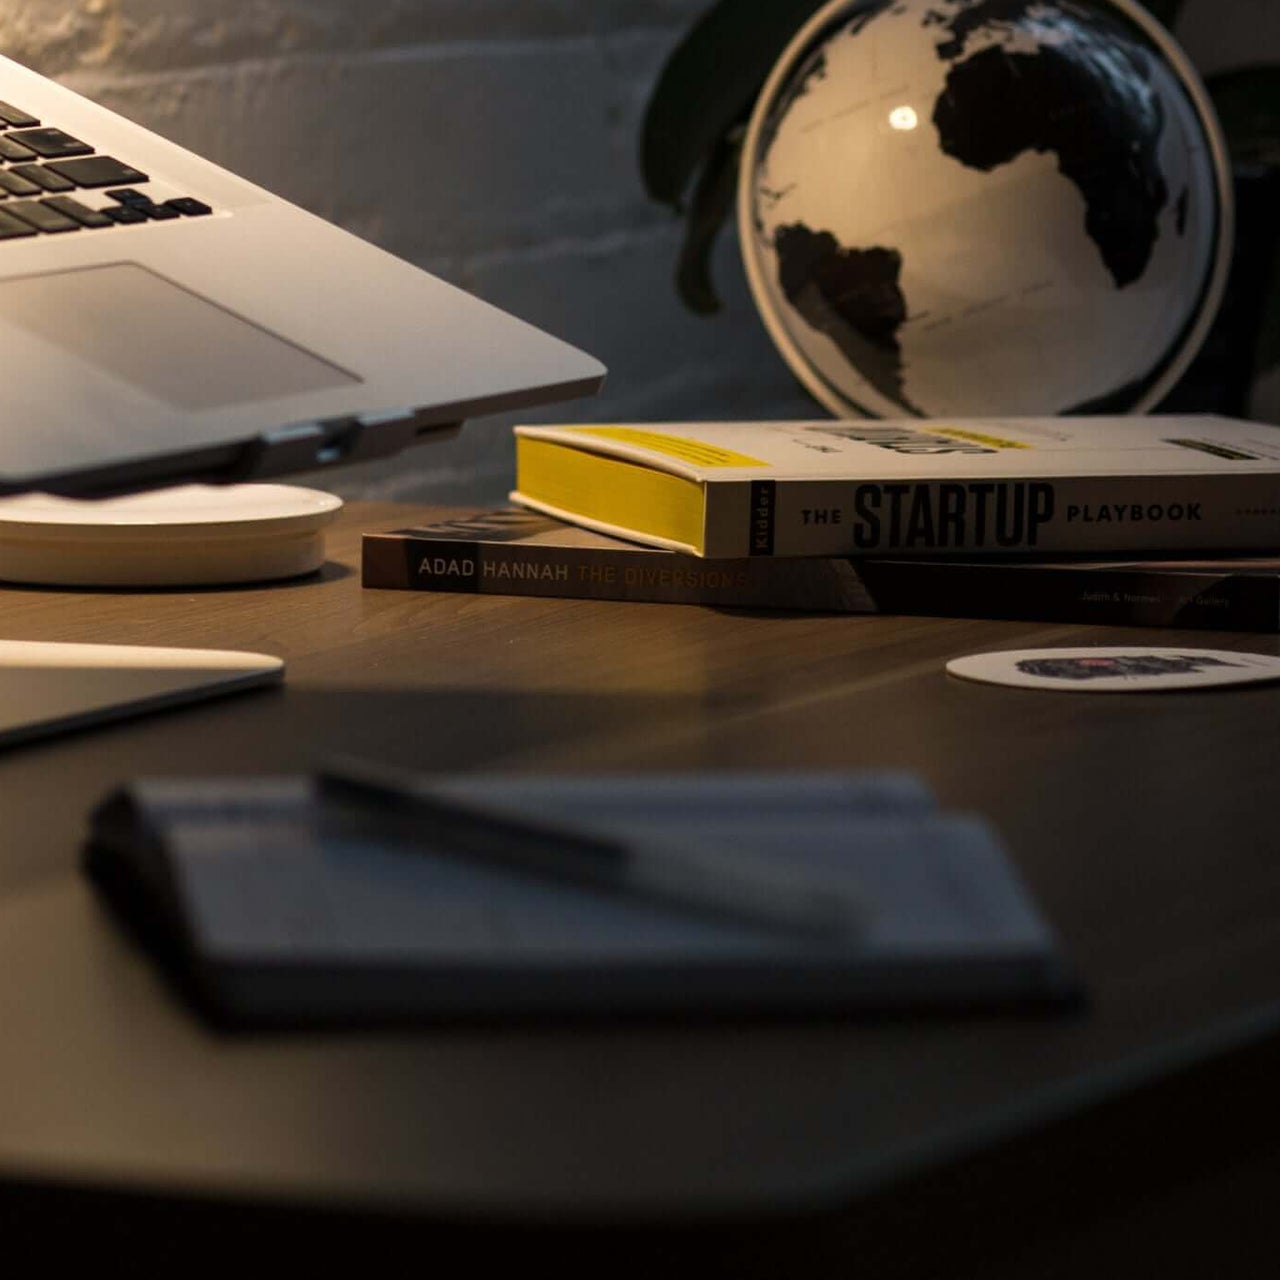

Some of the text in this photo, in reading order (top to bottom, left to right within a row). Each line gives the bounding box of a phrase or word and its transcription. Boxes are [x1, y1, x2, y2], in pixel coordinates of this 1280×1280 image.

[801, 483, 1202, 548] THE STARTUP PLAYBOOK
[418, 558, 747, 589] ADAD HANNAH THE DIVERSIONS
